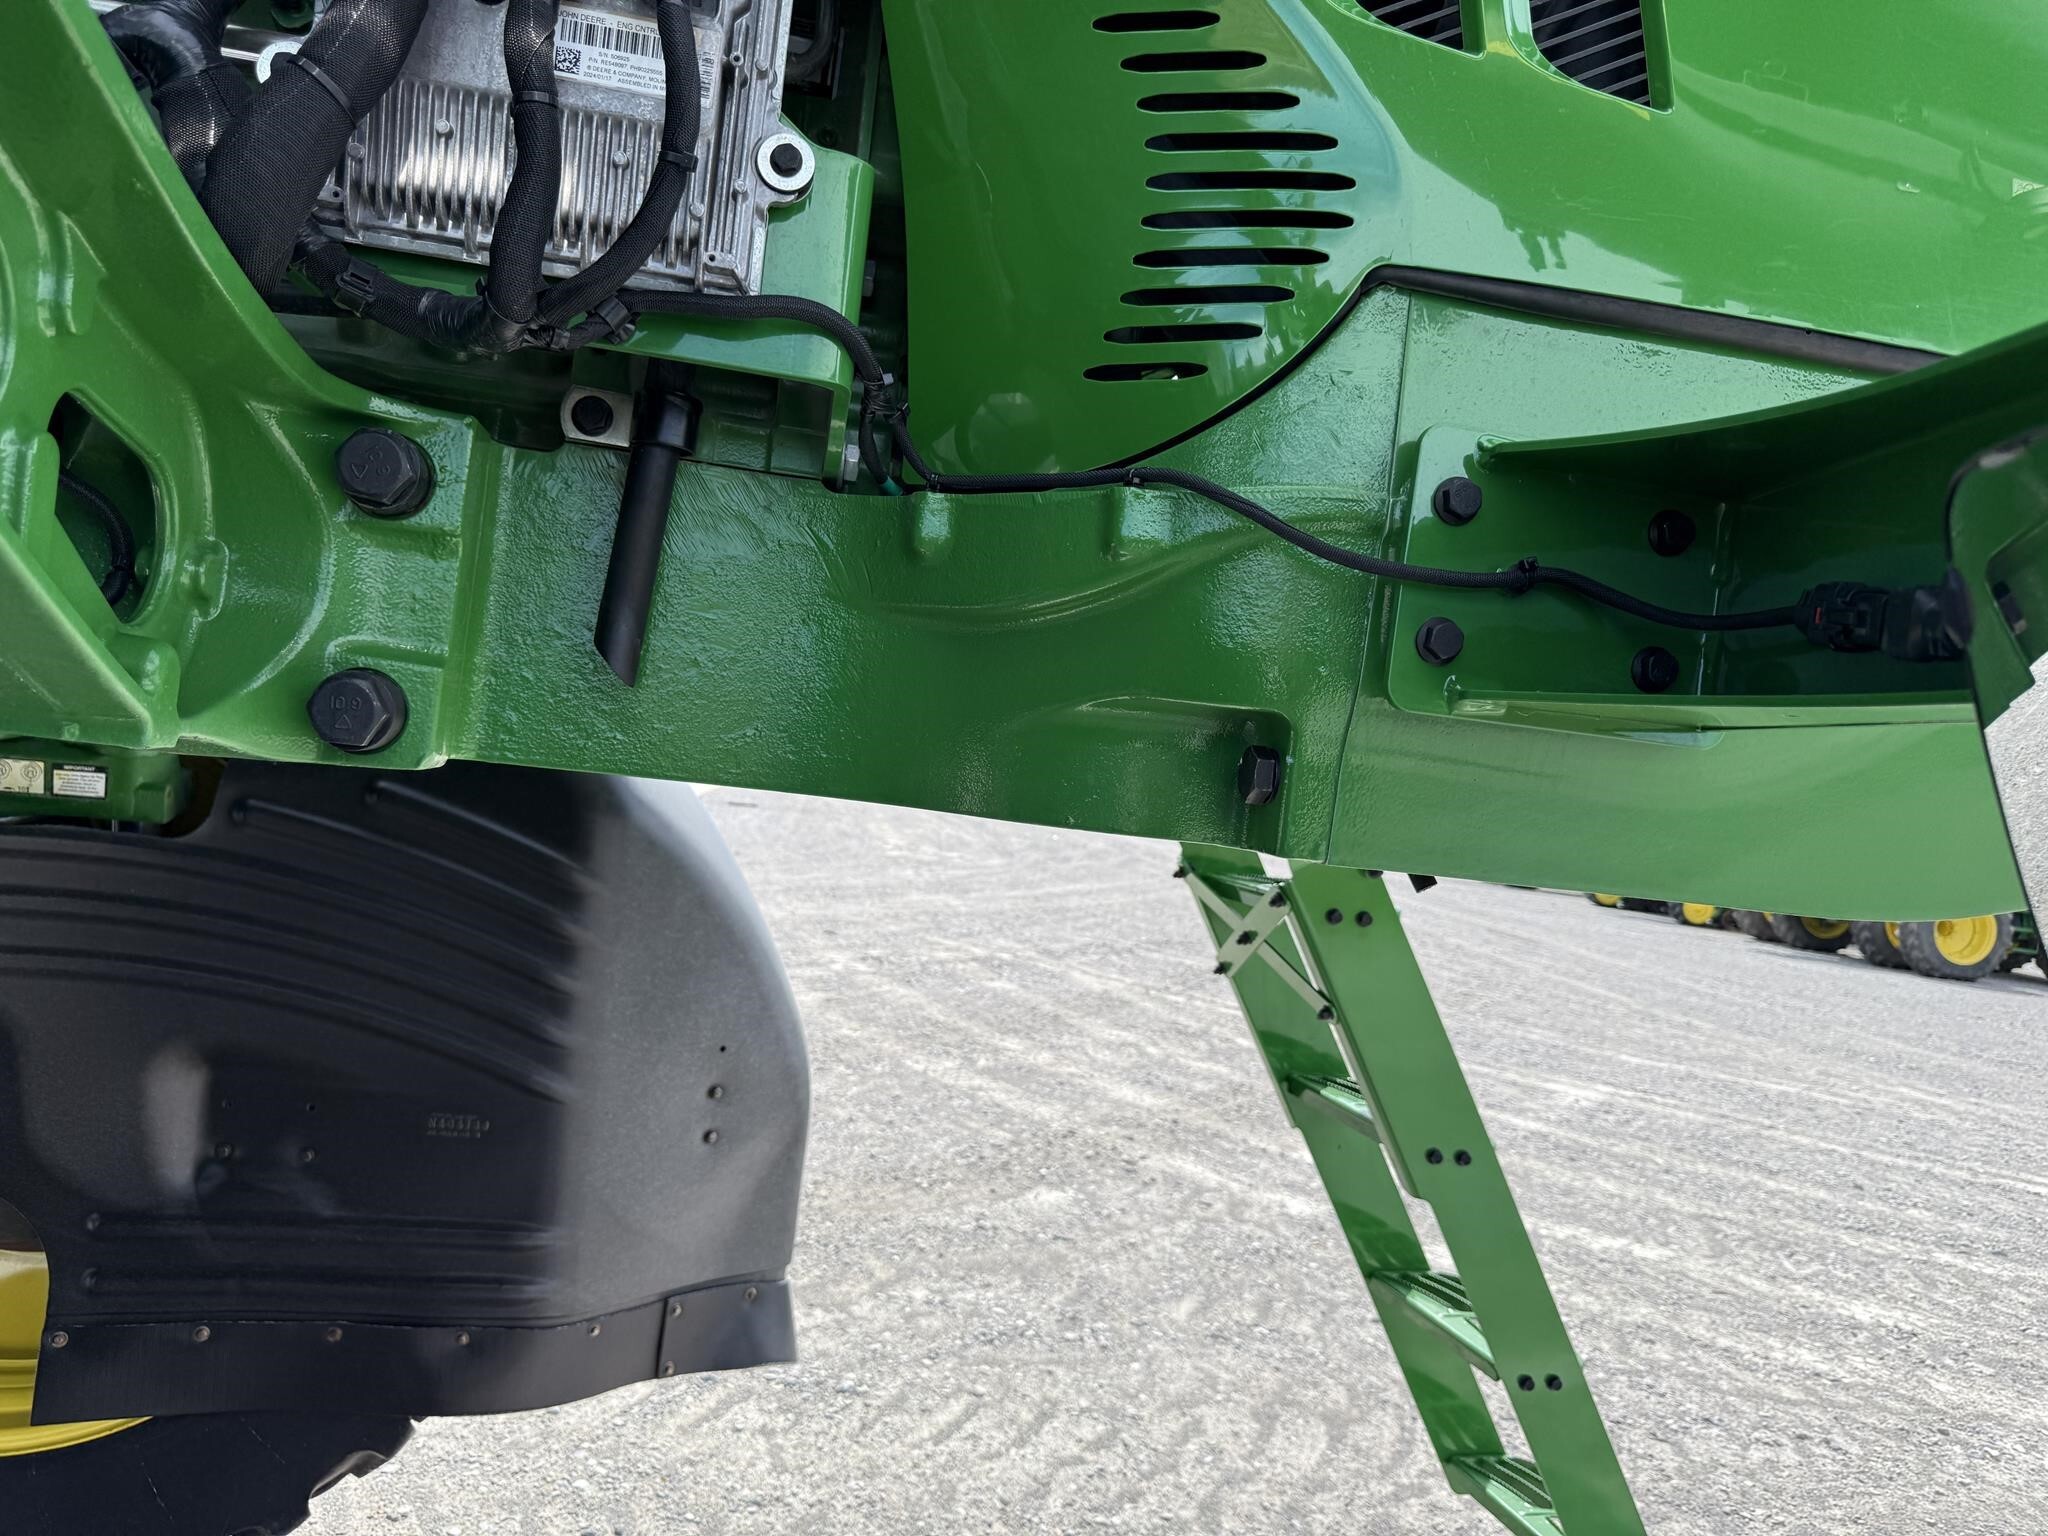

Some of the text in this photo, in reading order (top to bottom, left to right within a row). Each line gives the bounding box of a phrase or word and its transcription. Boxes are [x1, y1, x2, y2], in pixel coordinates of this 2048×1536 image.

[558, 9, 579, 20] JOHN
[580, 13, 607, 25] DEERE
[617, 21, 633, 31] ENG
[592, 66, 612, 75] DEERE
[617, 78, 652, 89] ASSEMBLED
